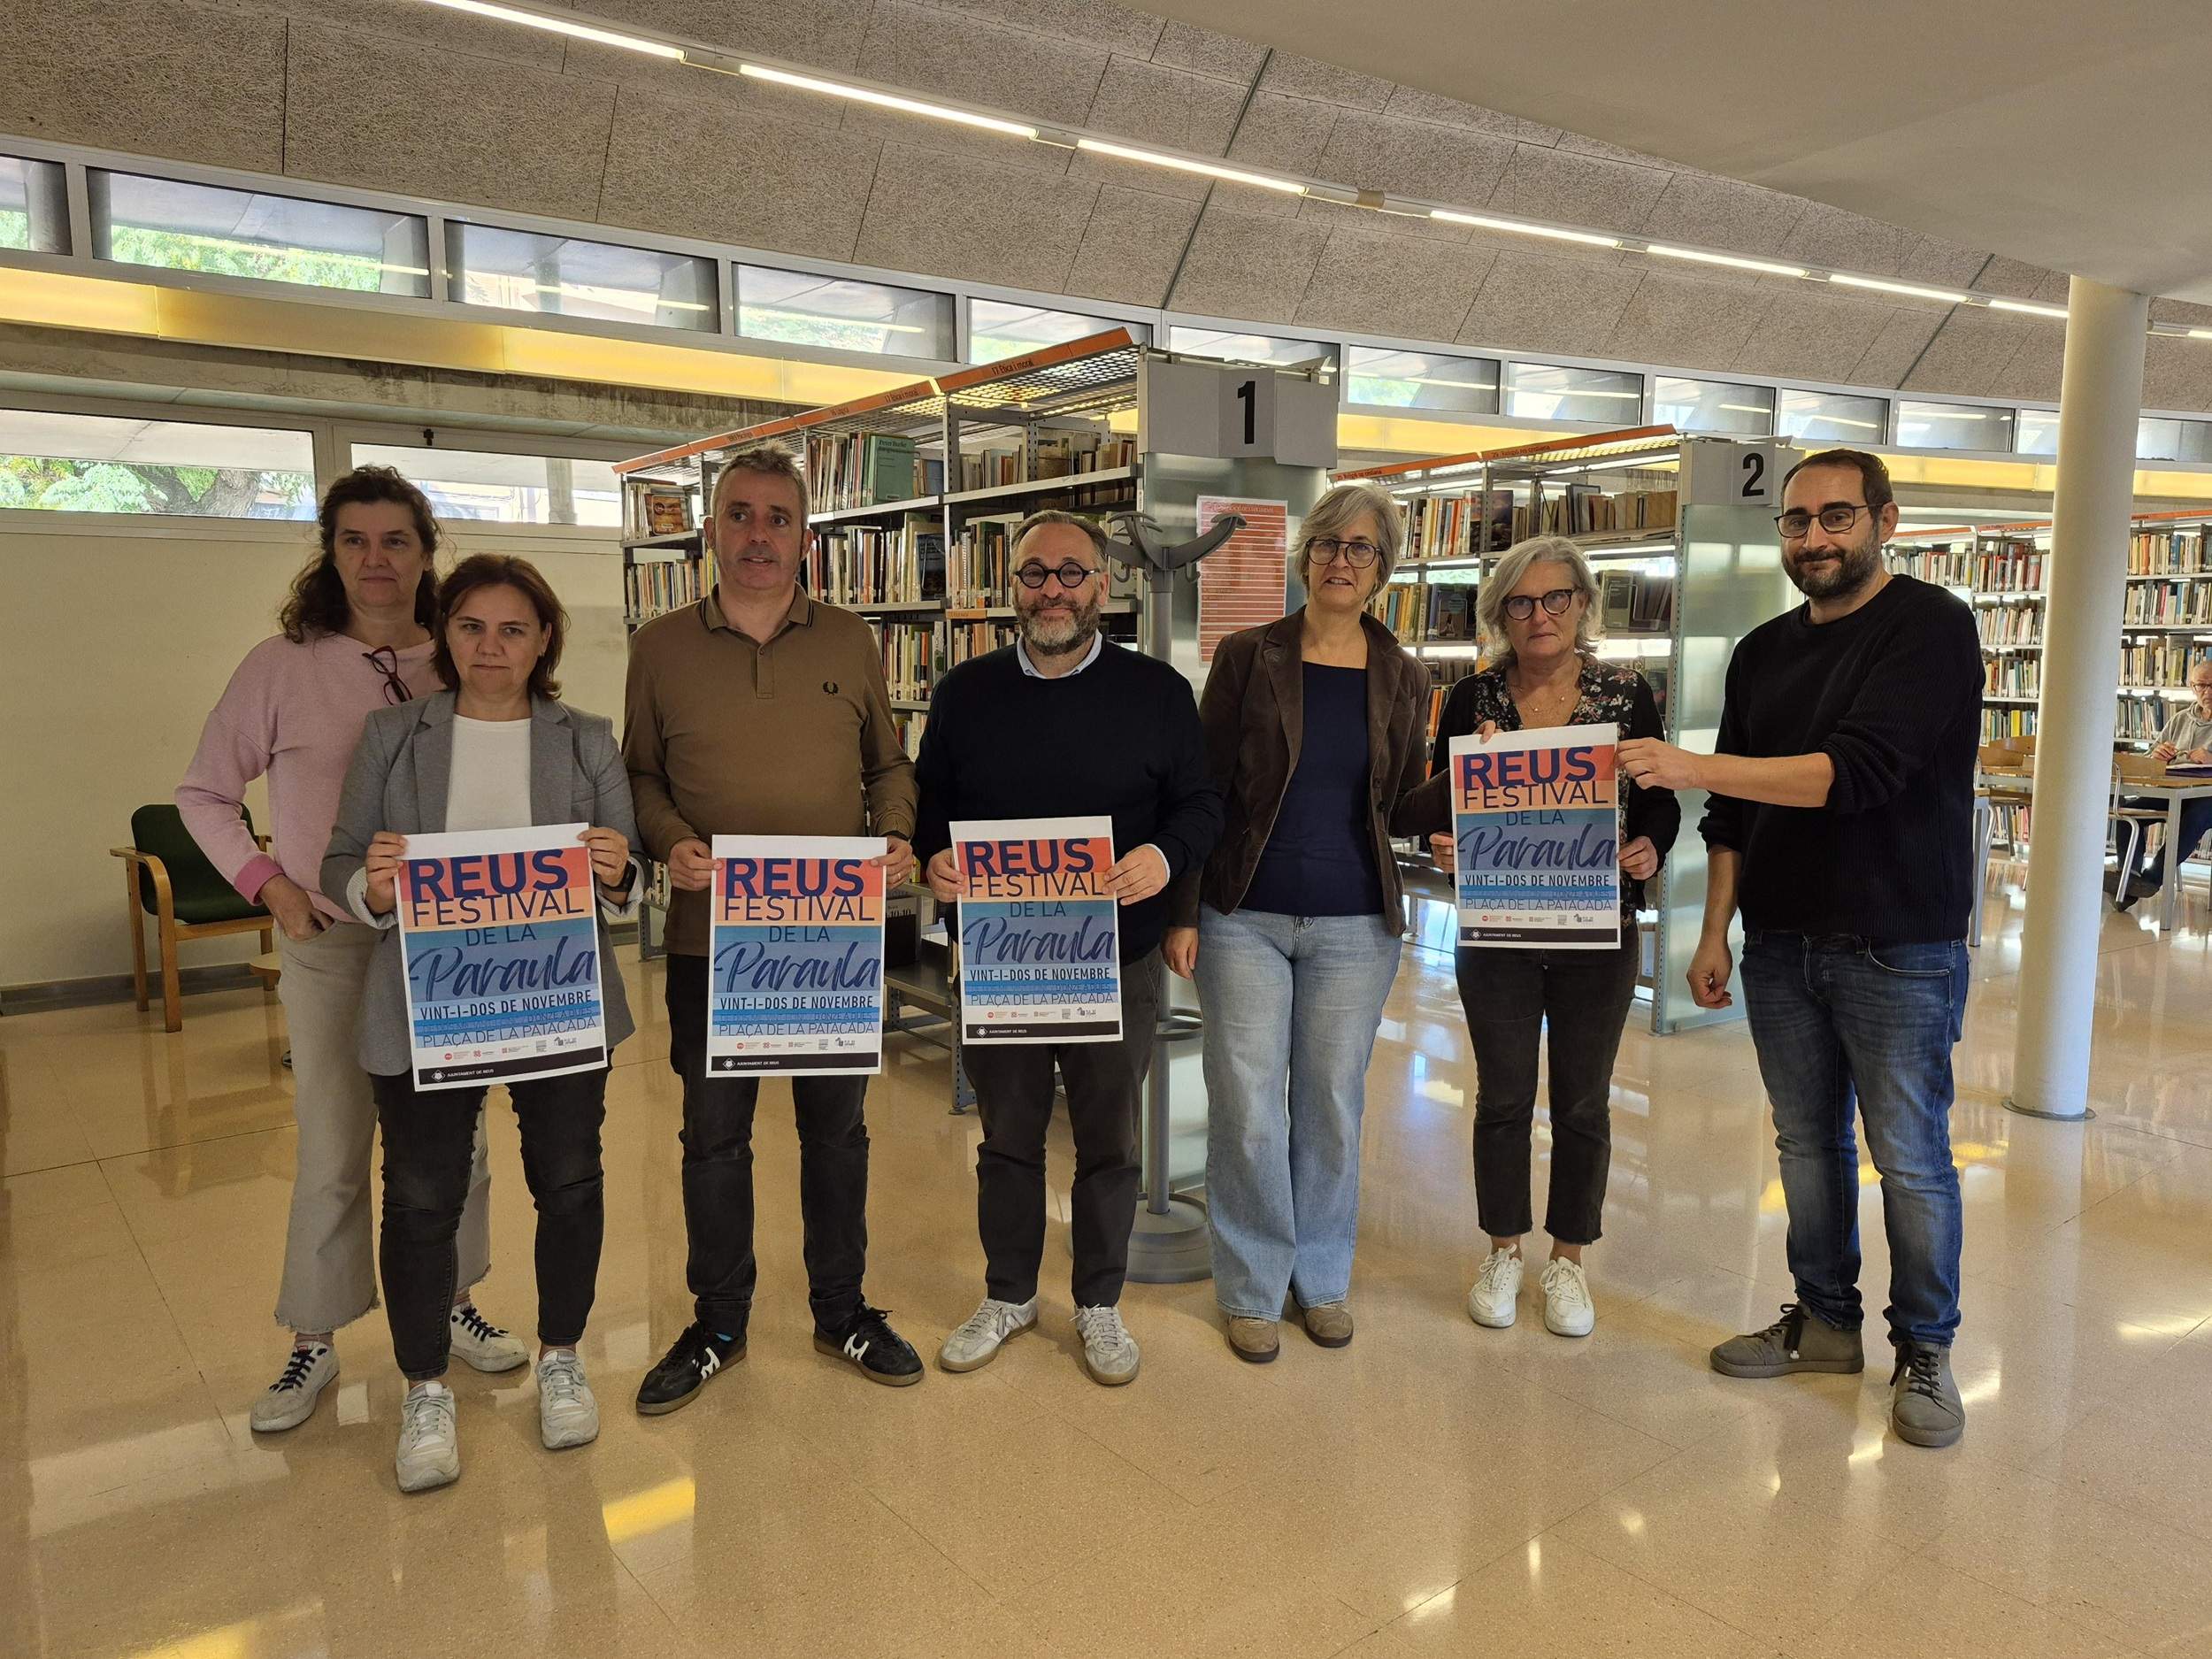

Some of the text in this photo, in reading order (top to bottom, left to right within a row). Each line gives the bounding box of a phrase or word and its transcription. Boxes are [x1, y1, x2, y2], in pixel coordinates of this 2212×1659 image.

[1236, 380, 1256, 445] 1
[1742, 452, 1764, 497] 2
[1463, 746, 1595, 790] REUS
[1464, 780, 1609, 809] FESTIVAL
[1506, 810, 1564, 826] DE LA
[965, 838, 1094, 877] REUS
[1457, 823, 1616, 870] Paraula
[410, 848, 568, 903] REUS
[726, 858, 864, 898] REUS
[969, 872, 1104, 897] FESTIVAL
[1465, 874, 1609, 886] VINT-I-DOS DE NOVEMBRE
[413, 889, 584, 926] FESTIVAL
[725, 895, 875, 921] FESTIVAL
[1010, 902, 1066, 918] DE LA
[1465, 899, 1612, 910] PLAÇA DE LA PATACADA
[466, 923, 537, 947] DE LA
[769, 926, 830, 942] DE LA
[963, 916, 1115, 965] Paraula
[409, 936, 595, 1002] Paraula
[713, 941, 880, 993] Paraula
[971, 968, 1110, 980] VINT-I-DOS DE NOVEMBRE
[420, 989, 592, 1020] VINT-I-DOS DE NOVEMBRE
[720, 995, 873, 1010] VINT-I-DOS DE NOVEMBRE
[971, 993, 1113, 1007] PLAÇA DE LA PATACADA
[423, 1032, 472, 1048] PLAÇA
[475, 1029, 495, 1043] DE
[500, 1026, 519, 1041] LA
[522, 1017, 596, 1038] PATACADA
[719, 1022, 874, 1038] PLAÇA DE LA PATACADA
